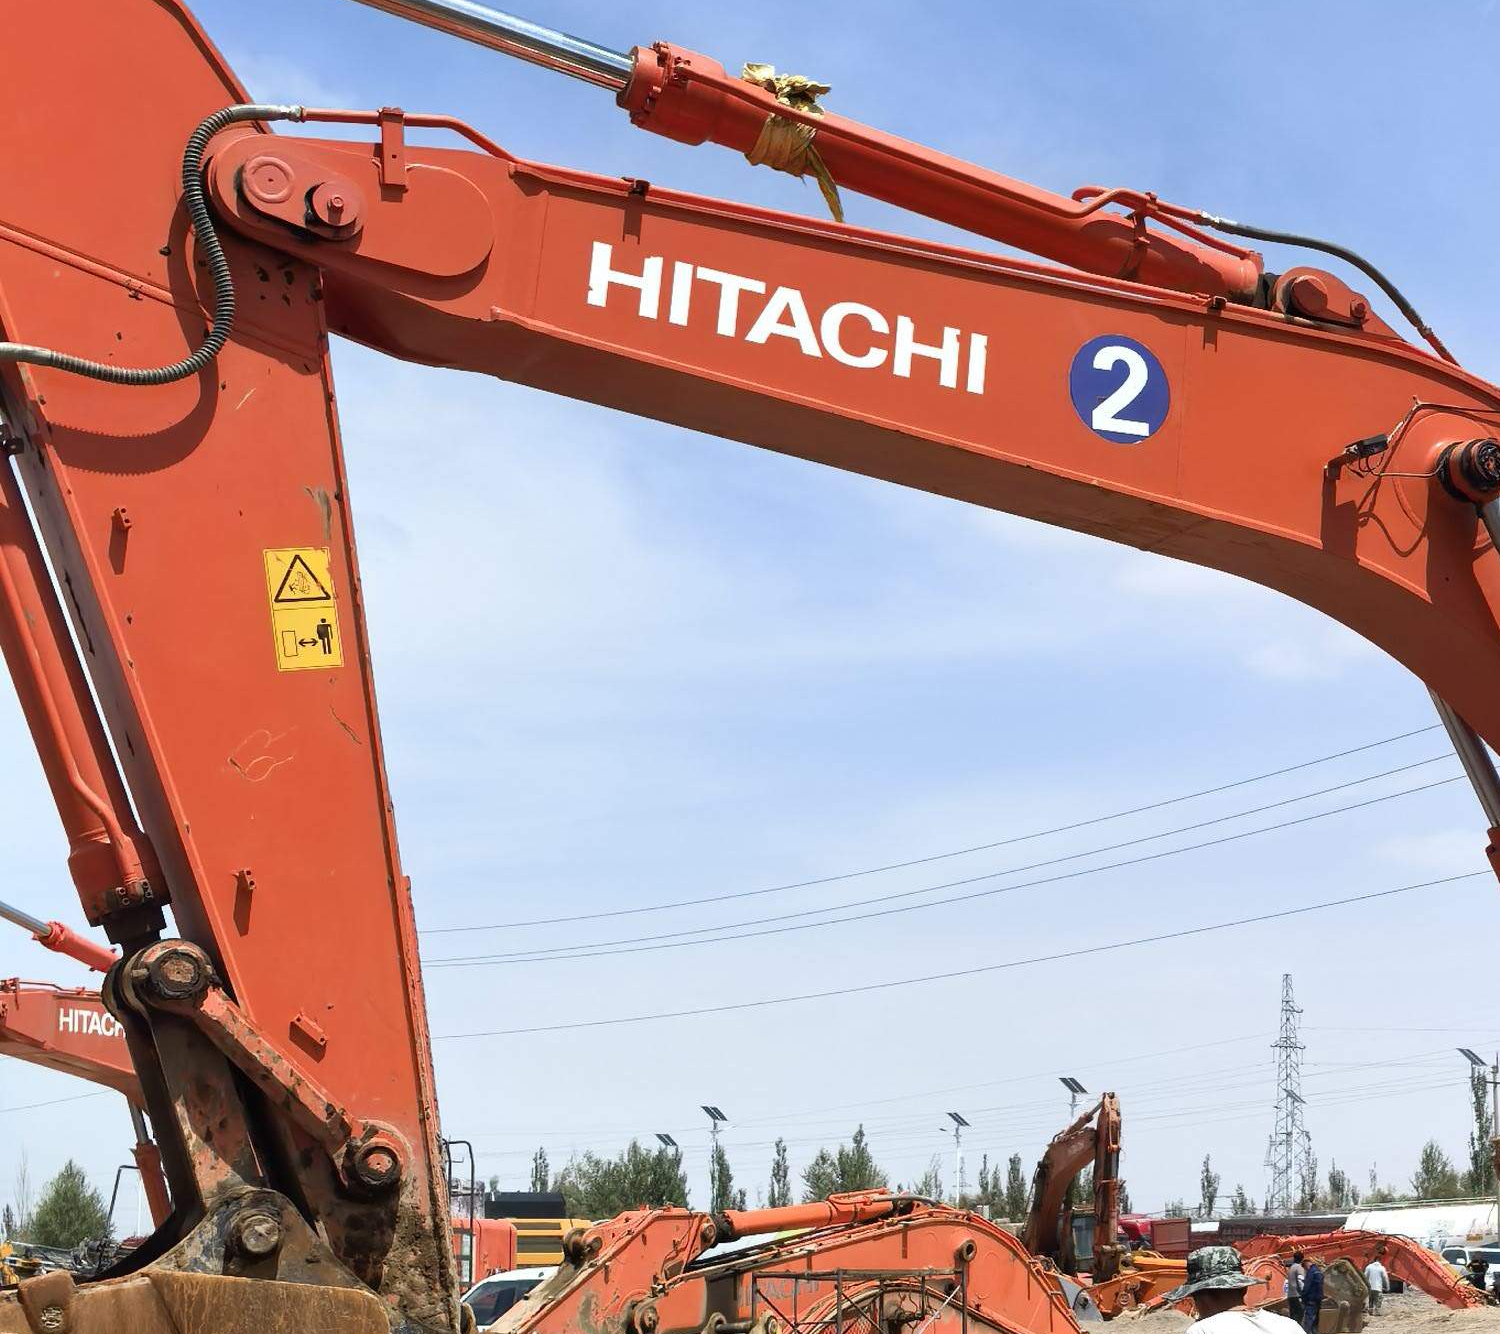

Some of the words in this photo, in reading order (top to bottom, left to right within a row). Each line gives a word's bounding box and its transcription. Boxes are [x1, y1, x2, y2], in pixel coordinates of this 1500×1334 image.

[586, 241, 988, 396] HITACHI
[1091, 345, 1150, 437] 2
[59, 1008, 126, 1038] HITACH
